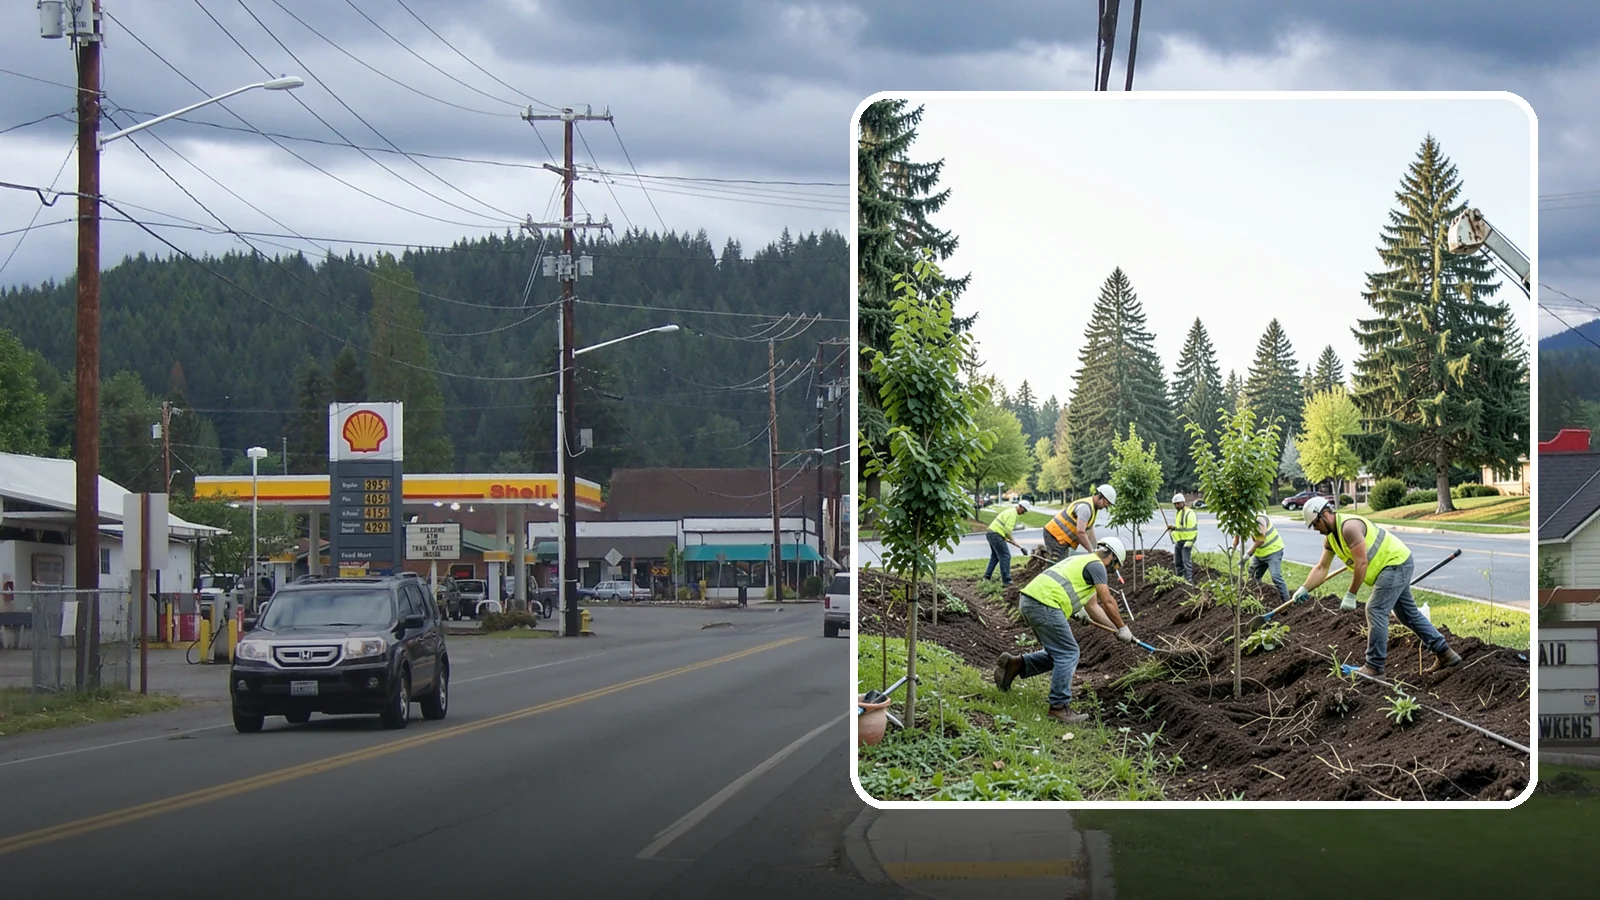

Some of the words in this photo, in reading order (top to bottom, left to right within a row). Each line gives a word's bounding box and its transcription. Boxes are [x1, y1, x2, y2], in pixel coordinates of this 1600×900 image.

[366, 480, 384, 490] 395
[490, 484, 547, 499] Shell
[366, 494, 384, 504] 405
[366, 508, 383, 518] 415
[366, 522, 384, 533] 429
[1539, 643, 1566, 665] AID
